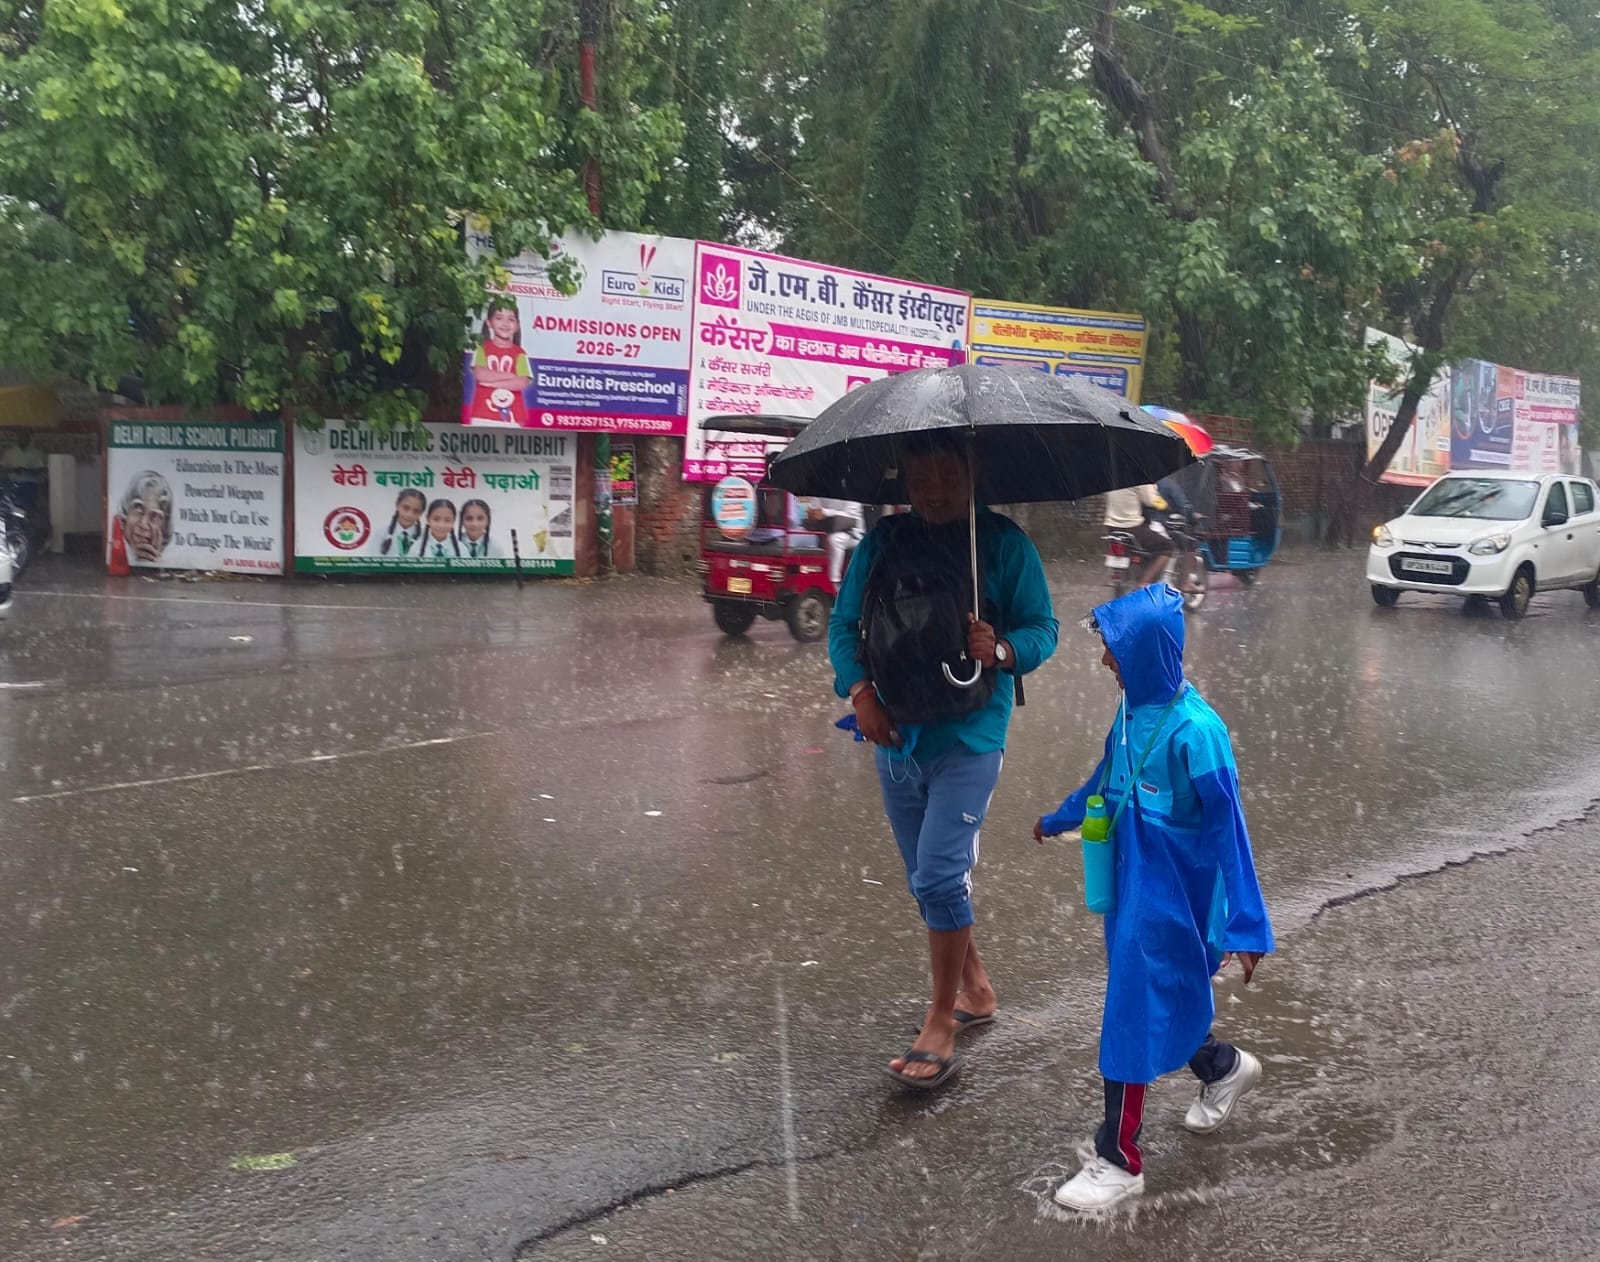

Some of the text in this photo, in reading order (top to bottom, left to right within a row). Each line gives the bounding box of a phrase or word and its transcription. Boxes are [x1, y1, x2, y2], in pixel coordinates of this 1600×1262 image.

[607, 276, 681, 296] Euro Kids
[852, 280, 896, 315] कैंसर
[532, 315, 681, 342] ADMISSIONS OPEN
[746, 300, 776, 317] UNDER
[778, 306, 794, 320] THE
[795, 308, 820, 324] AEGIS
[820, 312, 832, 325] OF
[832, 314, 848, 327] JMB
[849, 316, 909, 336] MULTISPECIALITY
[700, 314, 768, 353] कैंसर
[775, 336, 795, 352] का
[797, 337, 836, 359] इलाज
[837, 344, 860, 361] अब
[576, 340, 642, 358] 2026-27
[707, 356, 772, 378] कैंसर सर्जरी
[537, 373, 676, 395] Eurokids Preschool
[113, 424, 278, 448] DELHI PUBLIC SCHOOL PILIBHIT
[329, 429, 567, 456] DELHI PUBLC SCHOOL PILIBHIT
[224, 460, 233, 474] Is
[235, 460, 252, 475] The
[254, 461, 280, 476] Most
[331, 463, 542, 493] बेटी बचाओ बेटी पढ़ाओ
[184, 483, 264, 505] Powerful Weapon
[179, 507, 270, 527] Which You Can Use
[173, 531, 185, 546] To
[186, 532, 221, 553] Change
[223, 534, 241, 550] The
